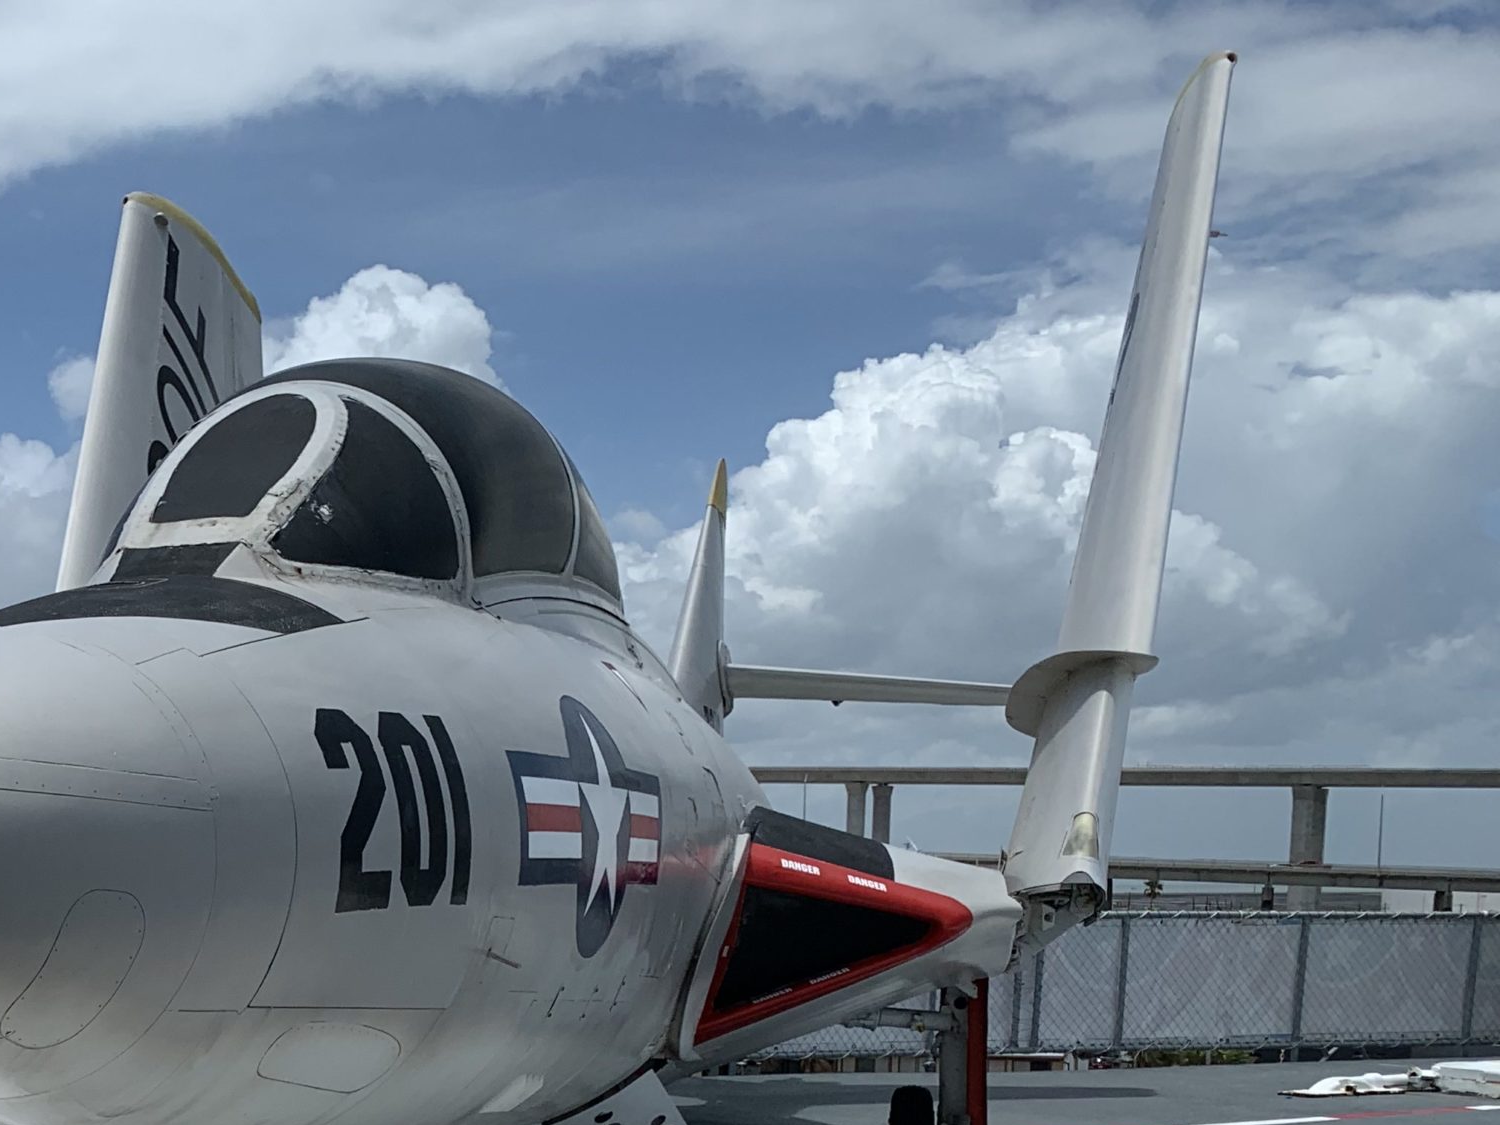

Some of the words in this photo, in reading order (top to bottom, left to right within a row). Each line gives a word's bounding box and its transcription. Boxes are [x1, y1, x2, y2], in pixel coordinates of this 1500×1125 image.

[314, 708, 472, 913] 201
[781, 859, 821, 876] DANGER
[847, 874, 888, 892] DANGER
